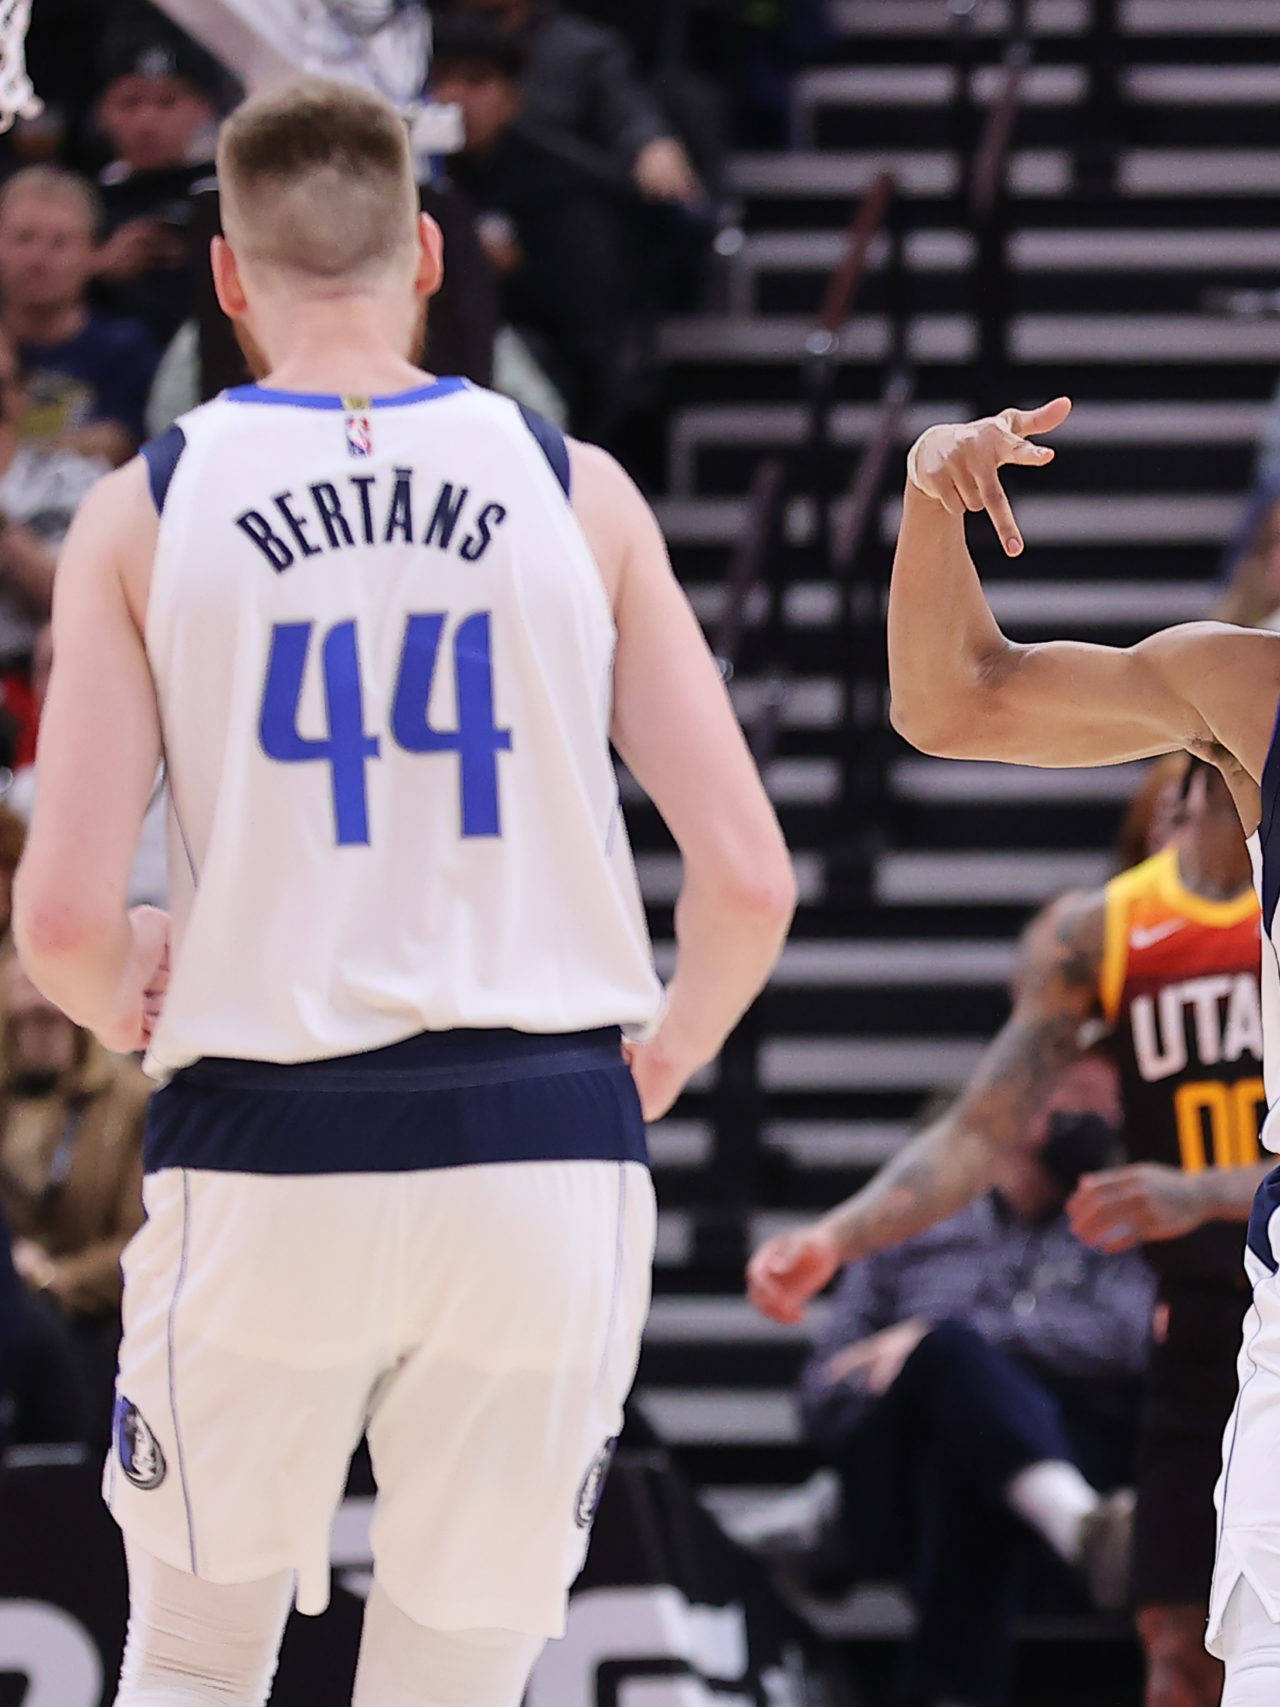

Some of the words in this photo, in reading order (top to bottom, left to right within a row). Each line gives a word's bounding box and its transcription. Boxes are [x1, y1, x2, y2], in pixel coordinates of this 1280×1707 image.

[235, 467, 507, 574] BERTĀNS
[258, 610, 514, 848] 44
[1130, 971, 1263, 1083] UTA
